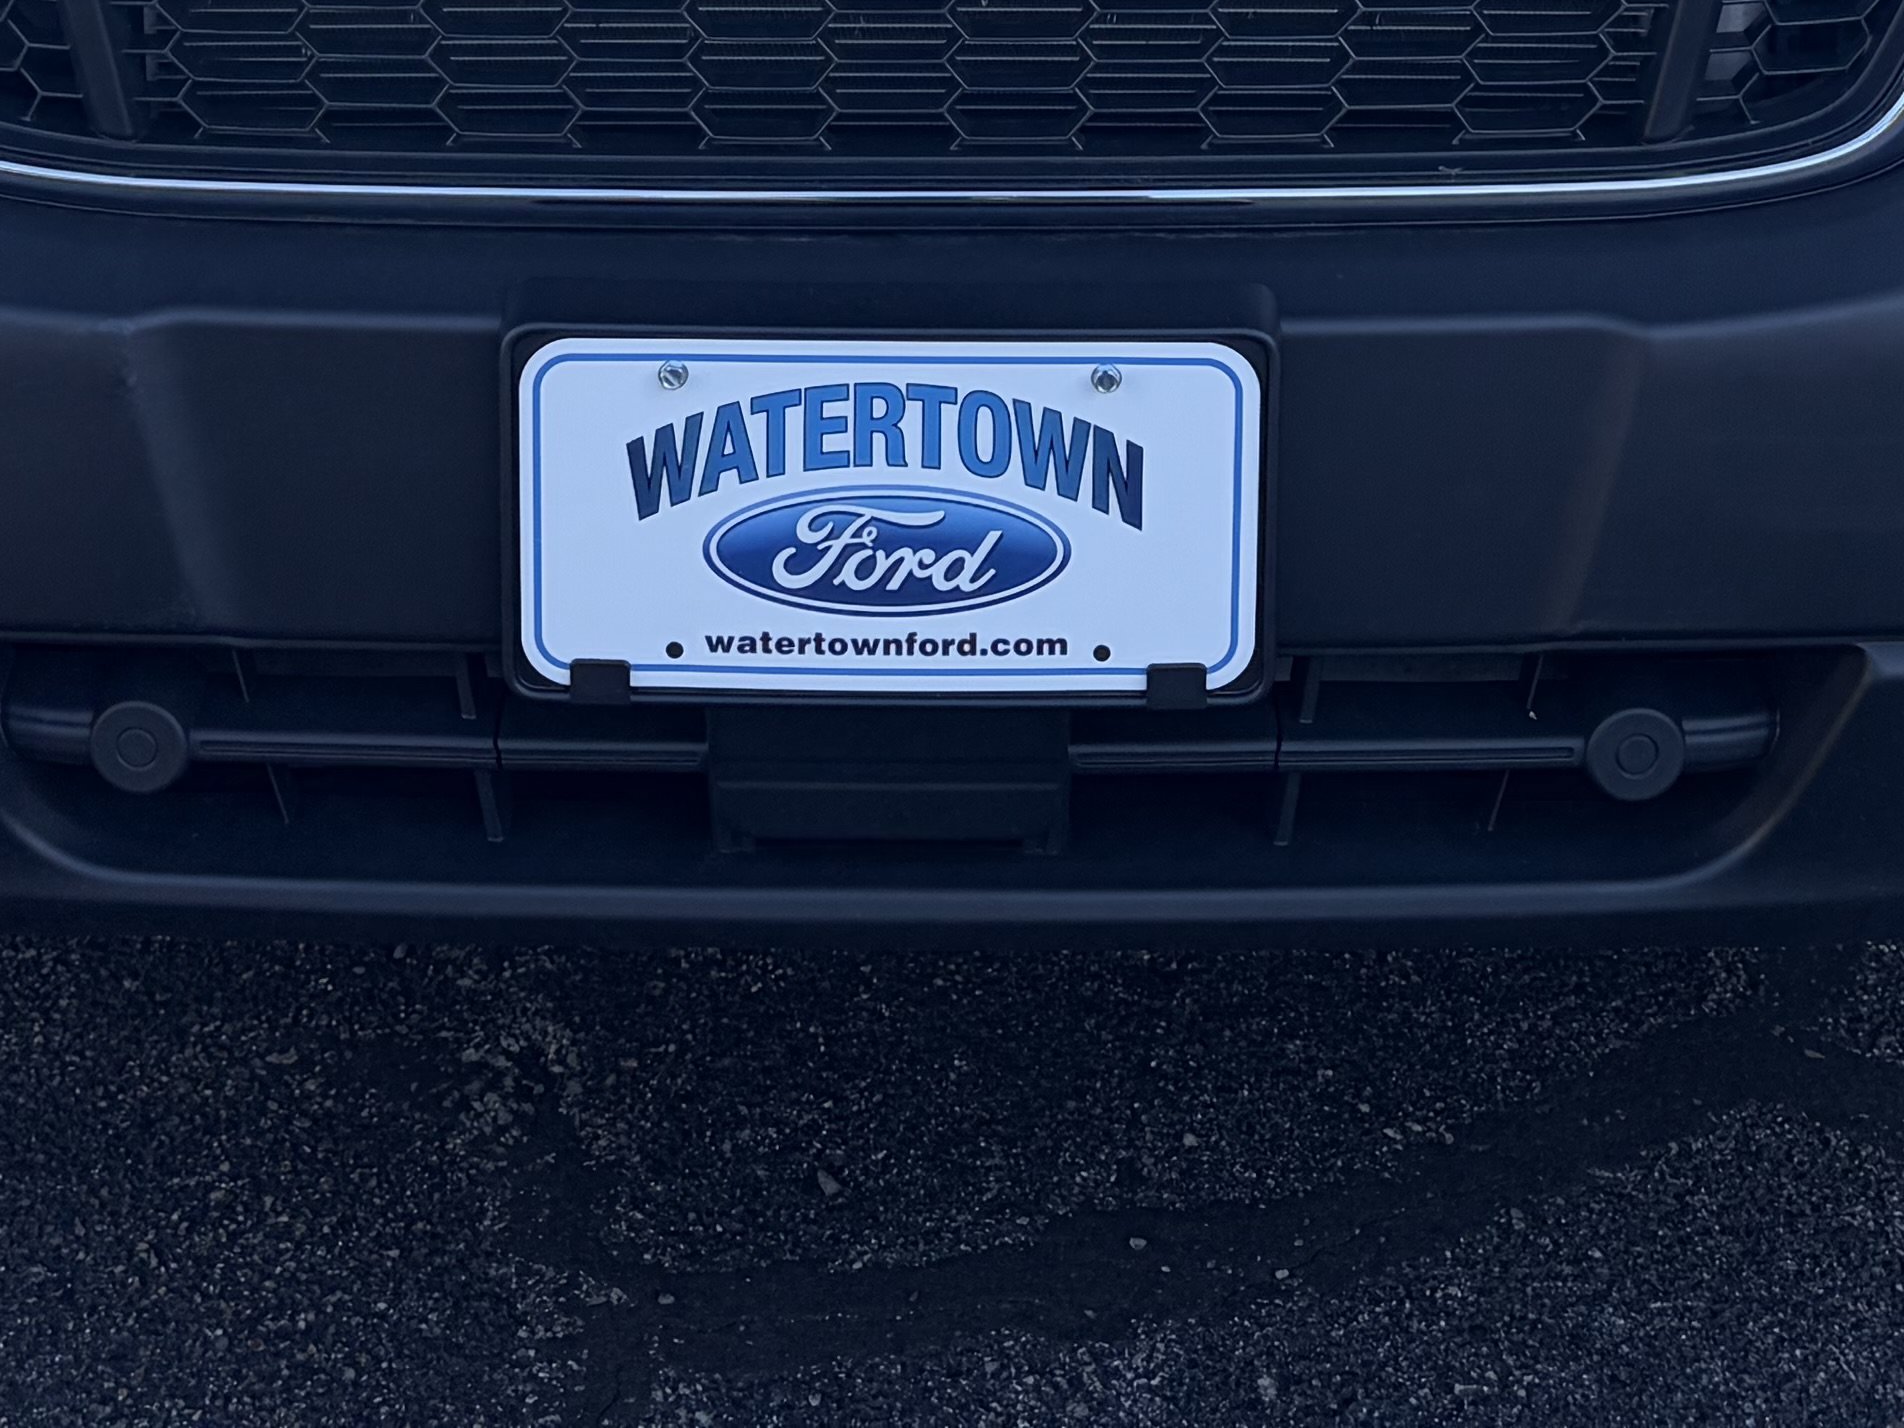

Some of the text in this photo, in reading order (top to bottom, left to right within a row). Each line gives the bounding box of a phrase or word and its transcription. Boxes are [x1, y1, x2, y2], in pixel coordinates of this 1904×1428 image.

[626, 381, 1145, 532] WATERTOWN
[773, 503, 1004, 593] Ford
[705, 631, 1069, 658] watertownford.com
